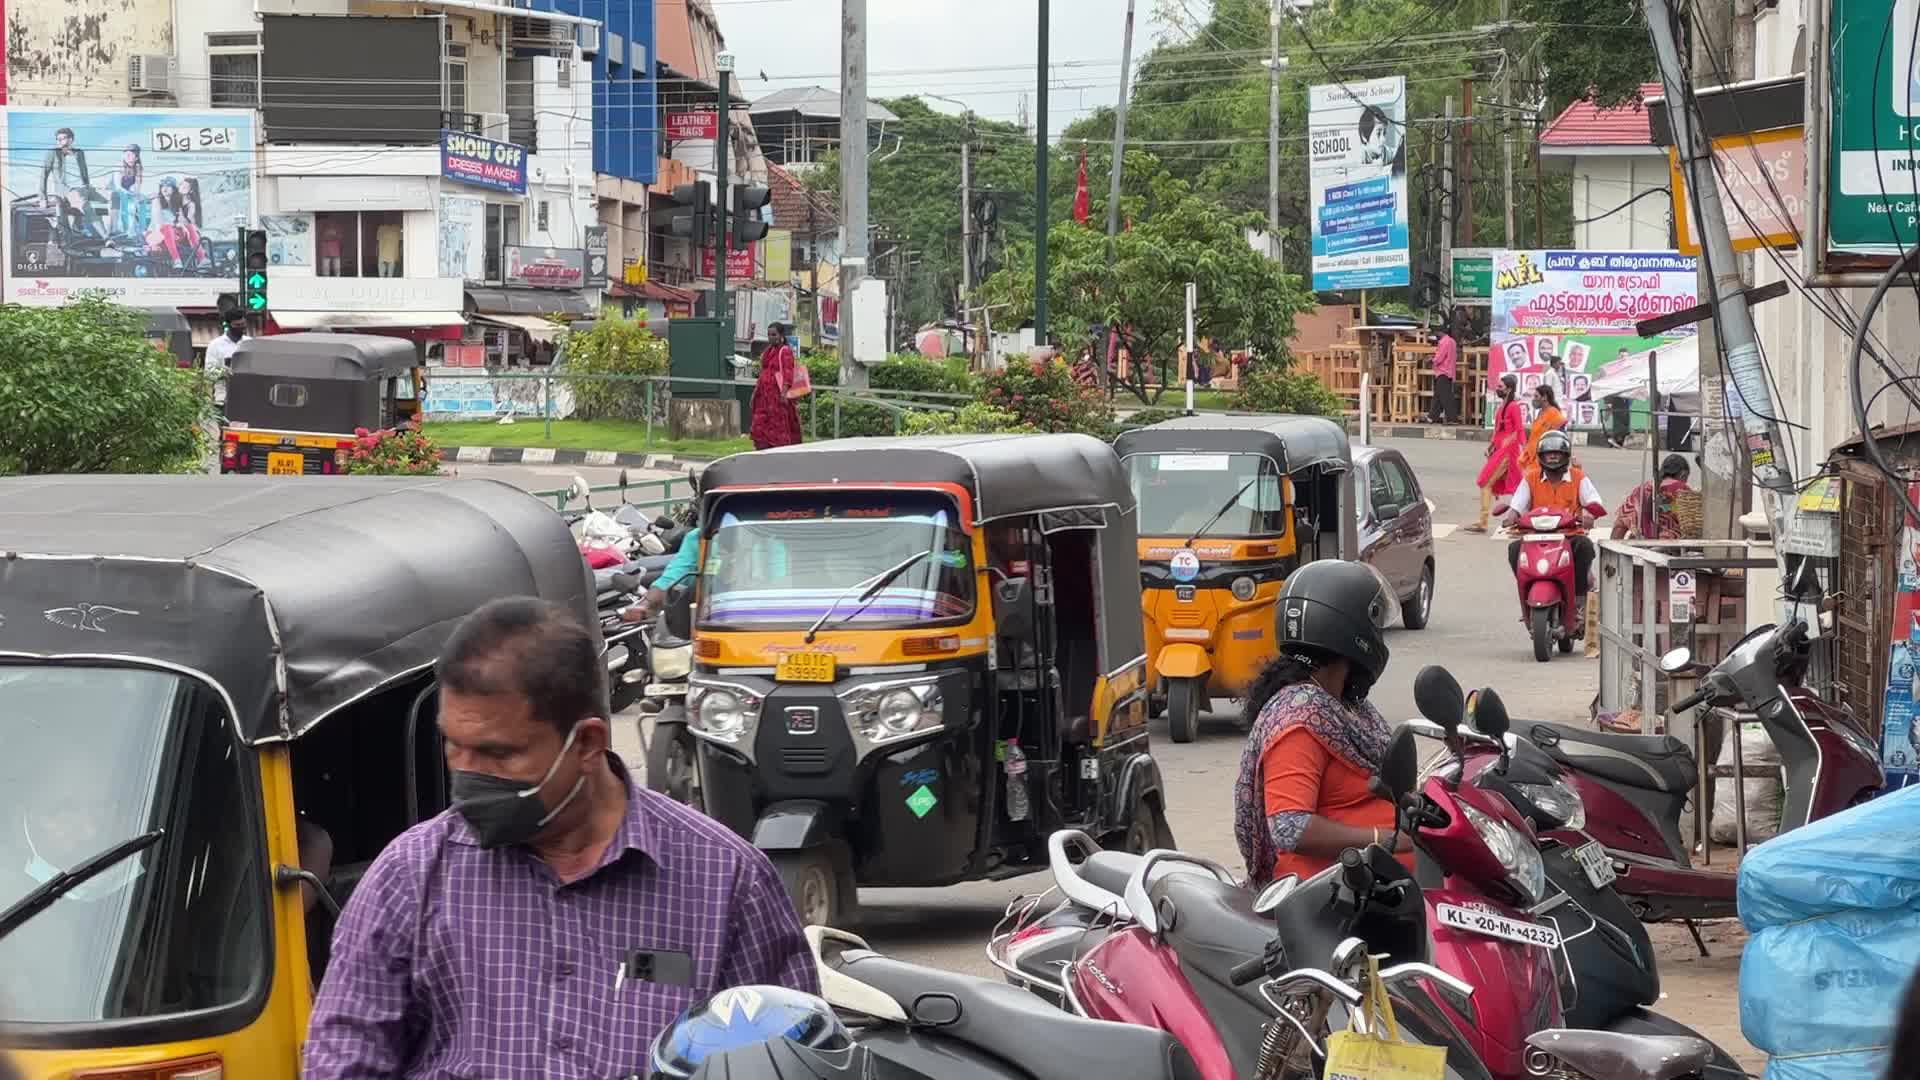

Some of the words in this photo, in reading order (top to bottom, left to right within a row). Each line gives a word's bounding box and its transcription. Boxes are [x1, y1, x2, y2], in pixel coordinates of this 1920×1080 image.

[671, 115, 712, 126] LEATHER
[680, 127, 704, 137] BAGS
[156, 132, 191, 152] Dig
[199, 127, 230, 146] Sel
[1312, 137, 1352, 155] SCHOOL
[446, 134, 491, 161] SHOW
[494, 144, 521, 167] OFF
[484, 164, 518, 181] MAKER
[1867, 202, 1893, 214] Near
[1179, 557, 1192, 566] TC
